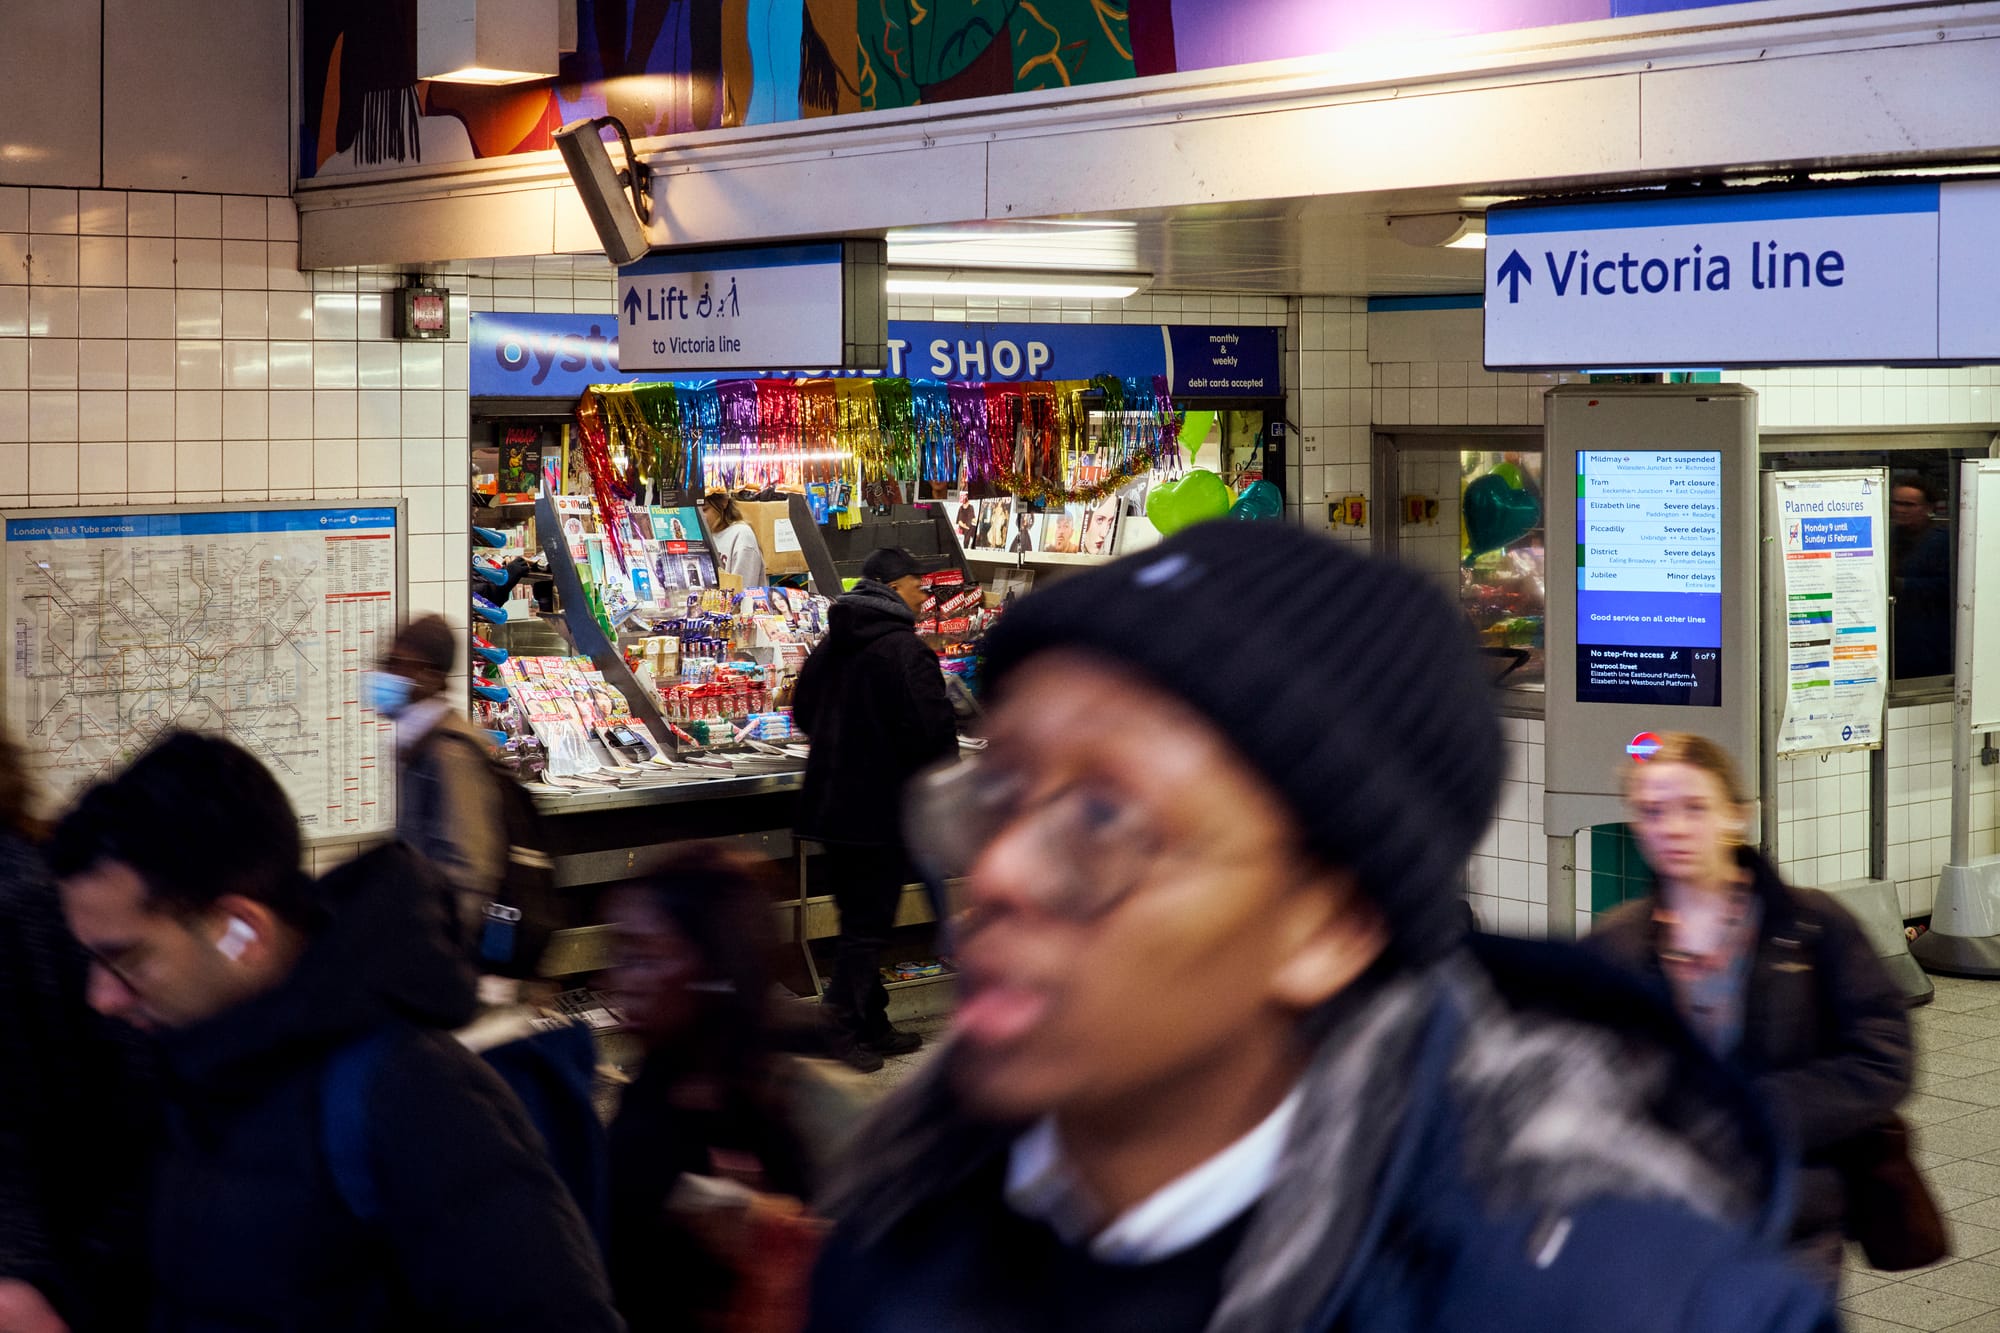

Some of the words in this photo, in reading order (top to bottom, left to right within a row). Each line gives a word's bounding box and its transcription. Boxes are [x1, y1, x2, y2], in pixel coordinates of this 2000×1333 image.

[1545, 243, 1730, 297] Victoria
[1751, 239, 1845, 290] line
[647, 286, 689, 321] Lift
[1209, 333, 1239, 345] monthly
[652, 338, 666, 355] to
[669, 335, 716, 354] Victoria
[718, 335, 741, 353] line
[1220, 344, 1227, 354] &
[929, 339, 1051, 377] SHOP
[1212, 356, 1238, 367] weekly
[1188, 378, 1208, 388] debit
[1209, 378, 1229, 388] cards
[1231, 378, 1264, 389] accepted
[1590, 455, 1622, 463] Mildmay
[1674, 456, 1715, 464] suspended
[1691, 503, 1716, 511] delays
[1785, 500, 1824, 513] Planned
[1827, 500, 1864, 511] closures
[13, 526, 51, 536] London's
[54, 526, 69, 534] Rail
[71, 525, 77, 533] &
[80, 525, 100, 534] Tube
[101, 524, 134, 533] services
[1590, 525, 1625, 533] Piccadilly
[1691, 526, 1716, 534] delays
[1804, 524, 1828, 533] Monday
[1834, 523, 1848, 531] until
[1804, 535, 1827, 544] Sunday
[1834, 534, 1858, 543] February
[1691, 549, 1716, 557] delays
[1691, 573, 1716, 581] delays
[1590, 613, 1611, 621] Good
[1612, 614, 1640, 622] service
[1664, 615, 1686, 623] other
[1603, 650, 1638, 659] step-free
[1701, 652, 1710, 660] of
[1590, 662, 1619, 670] Liverpool
